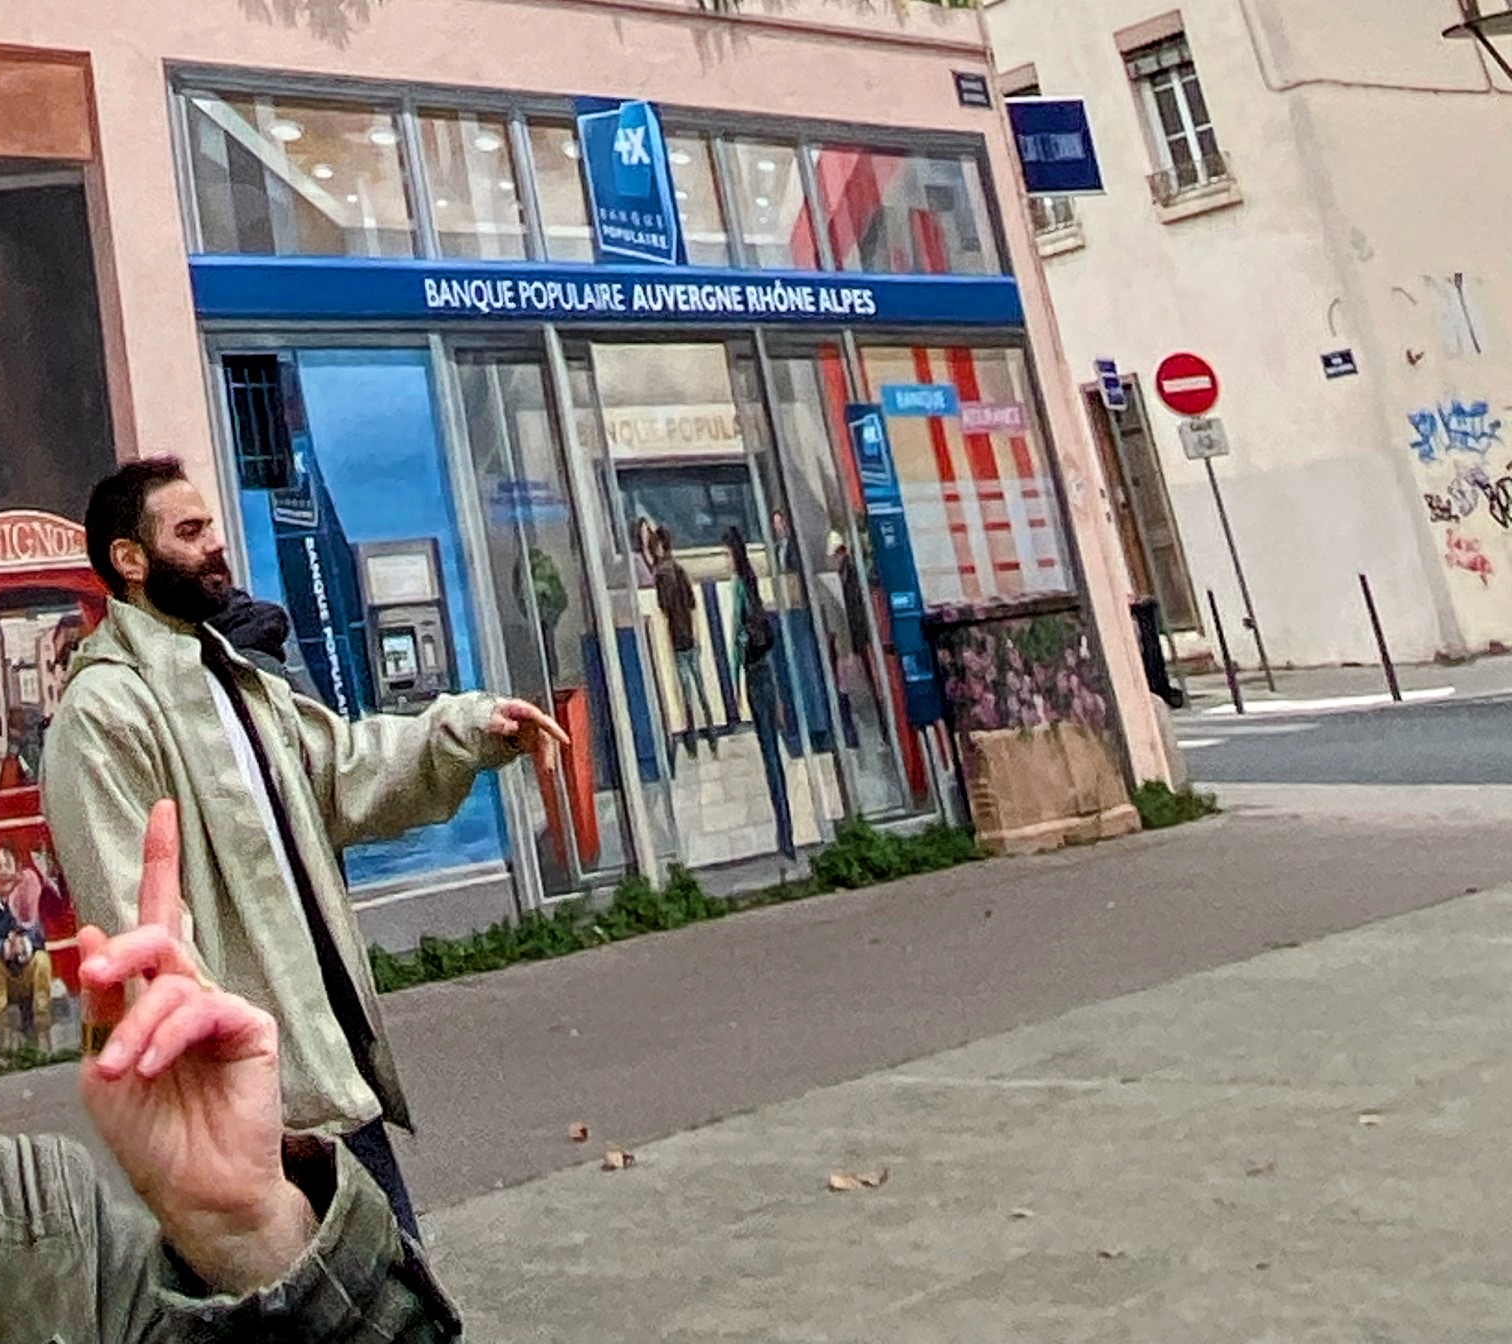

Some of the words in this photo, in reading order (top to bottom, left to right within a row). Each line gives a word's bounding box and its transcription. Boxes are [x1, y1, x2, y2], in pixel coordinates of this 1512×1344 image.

[424, 278, 516, 312] BANQUE
[518, 280, 626, 311] POPULAIRE
[632, 283, 745, 312] AUVERGNE
[745, 279, 817, 313] RHÔNE
[819, 286, 877, 314] ALPES
